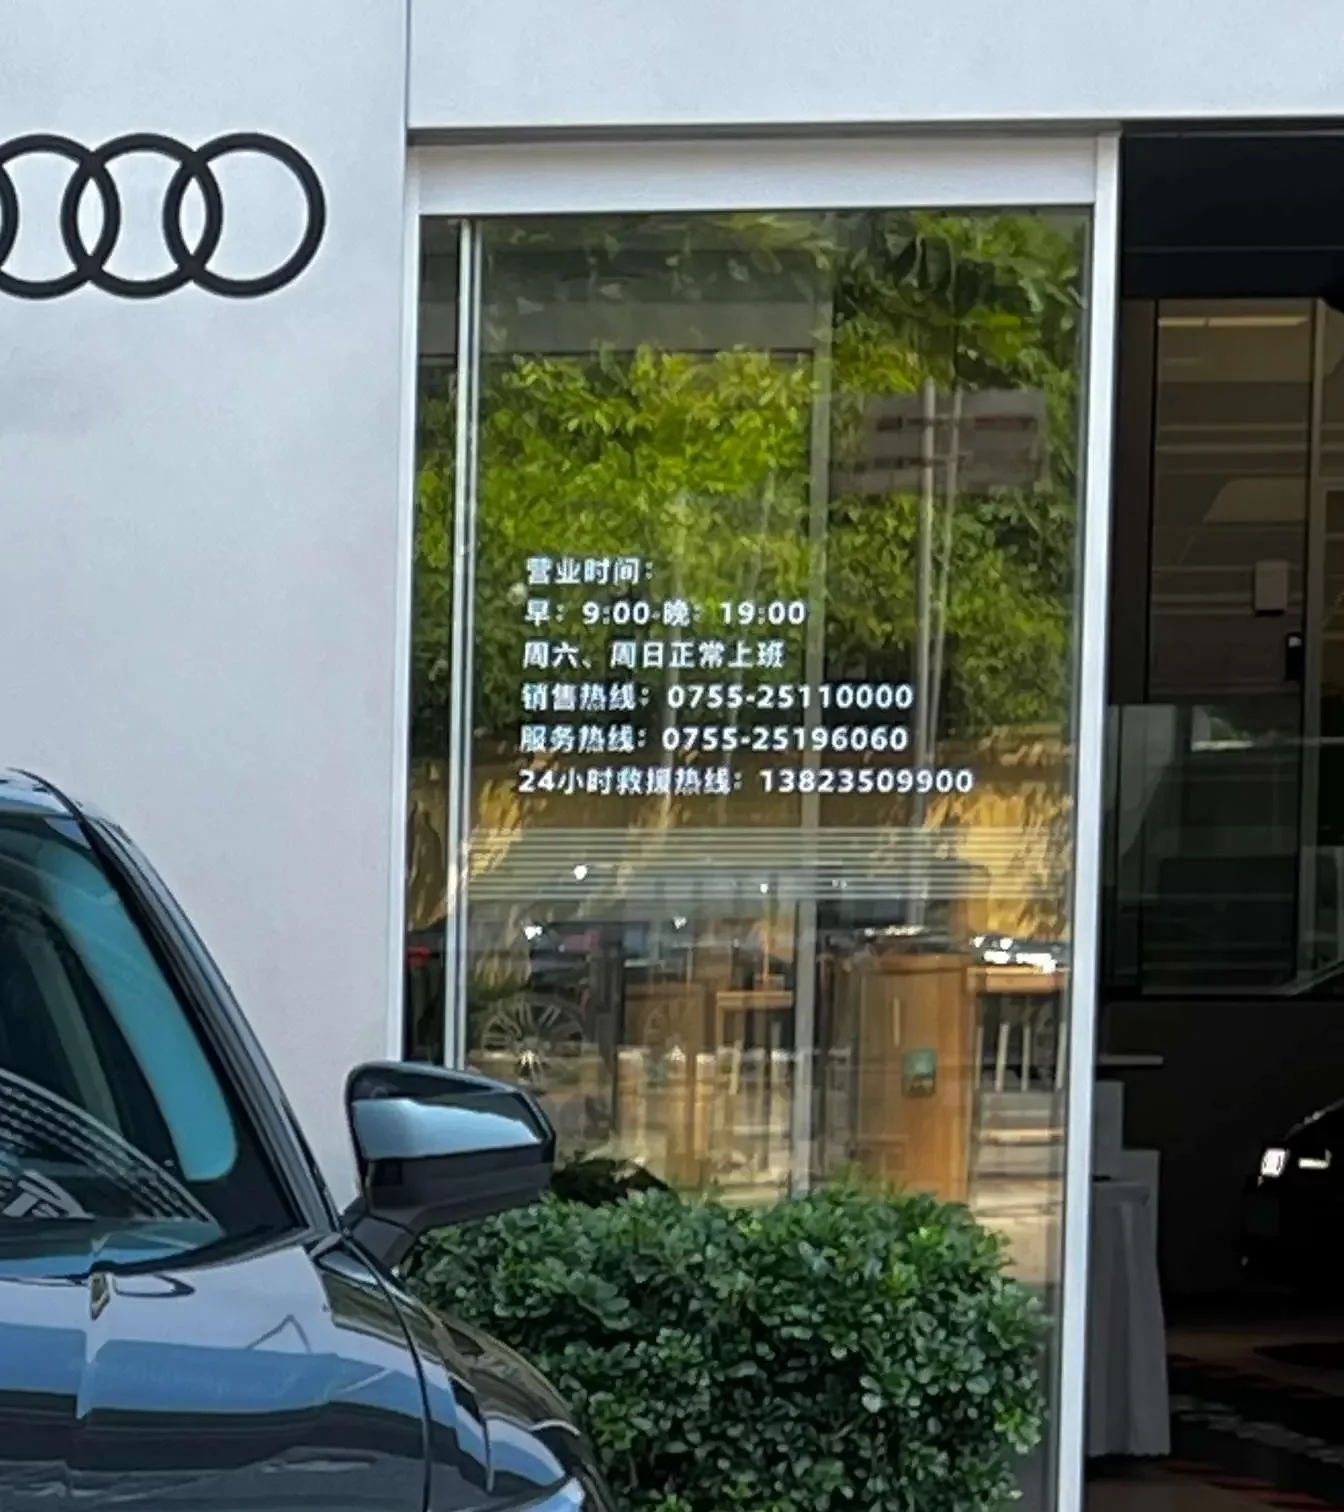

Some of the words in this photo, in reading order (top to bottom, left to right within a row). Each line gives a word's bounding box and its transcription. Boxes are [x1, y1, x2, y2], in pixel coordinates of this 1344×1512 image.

[525, 556, 654, 585] 营业时间：
[523, 640, 786, 669] 周六、周日正常上班
